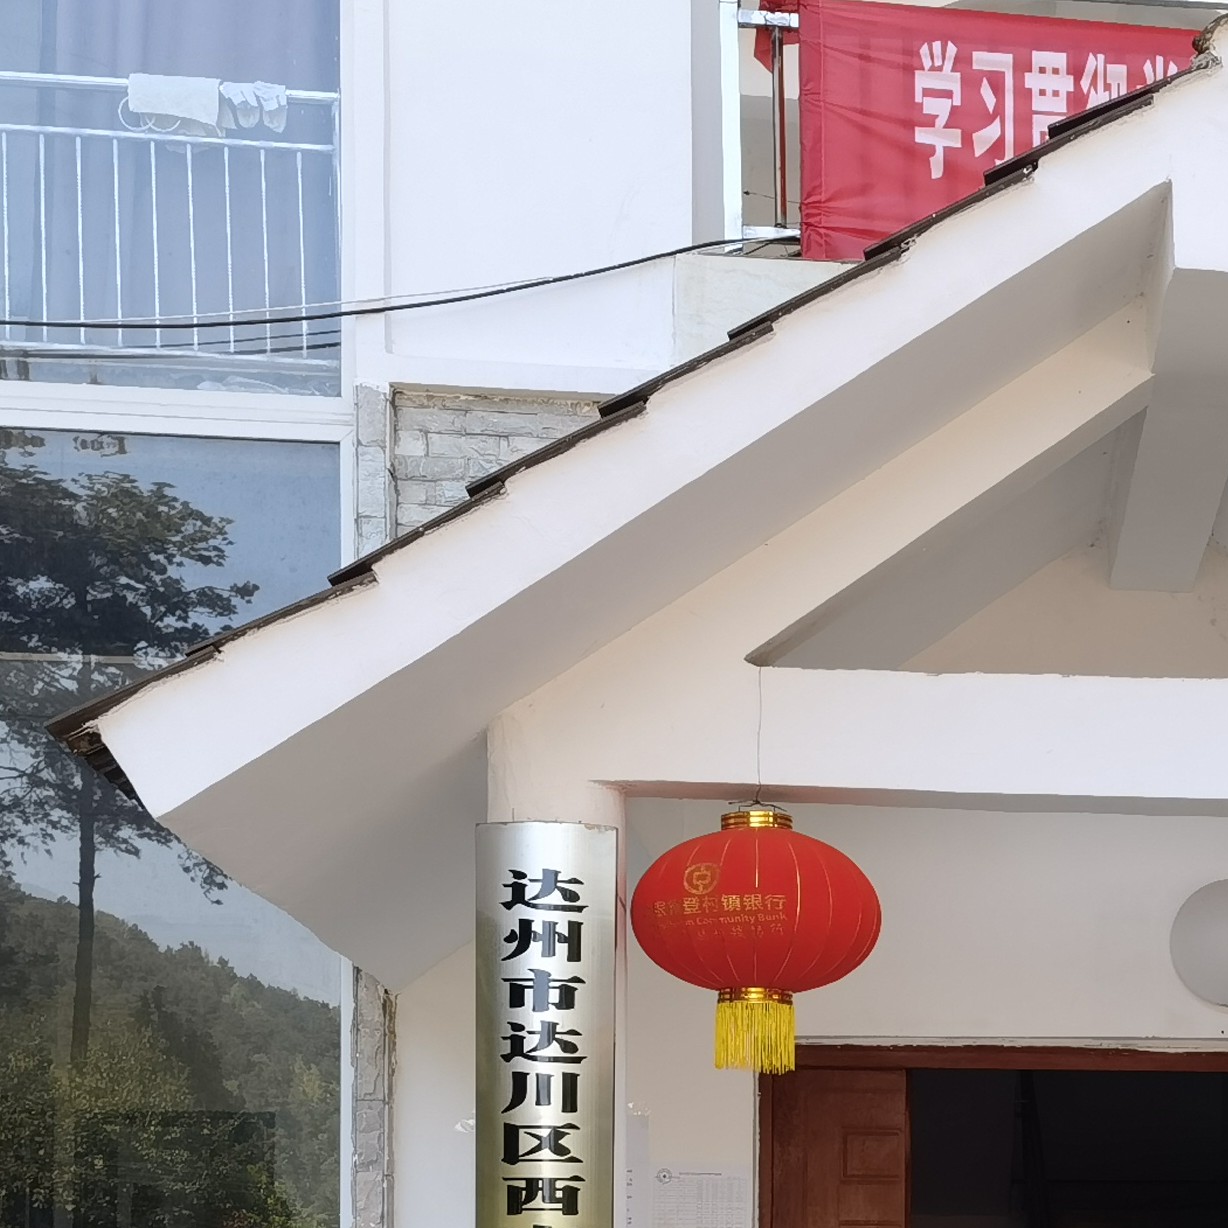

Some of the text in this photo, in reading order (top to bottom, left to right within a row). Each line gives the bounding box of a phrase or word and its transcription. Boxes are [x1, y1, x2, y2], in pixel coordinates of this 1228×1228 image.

[653, 893, 786, 916] 登村镇银行
